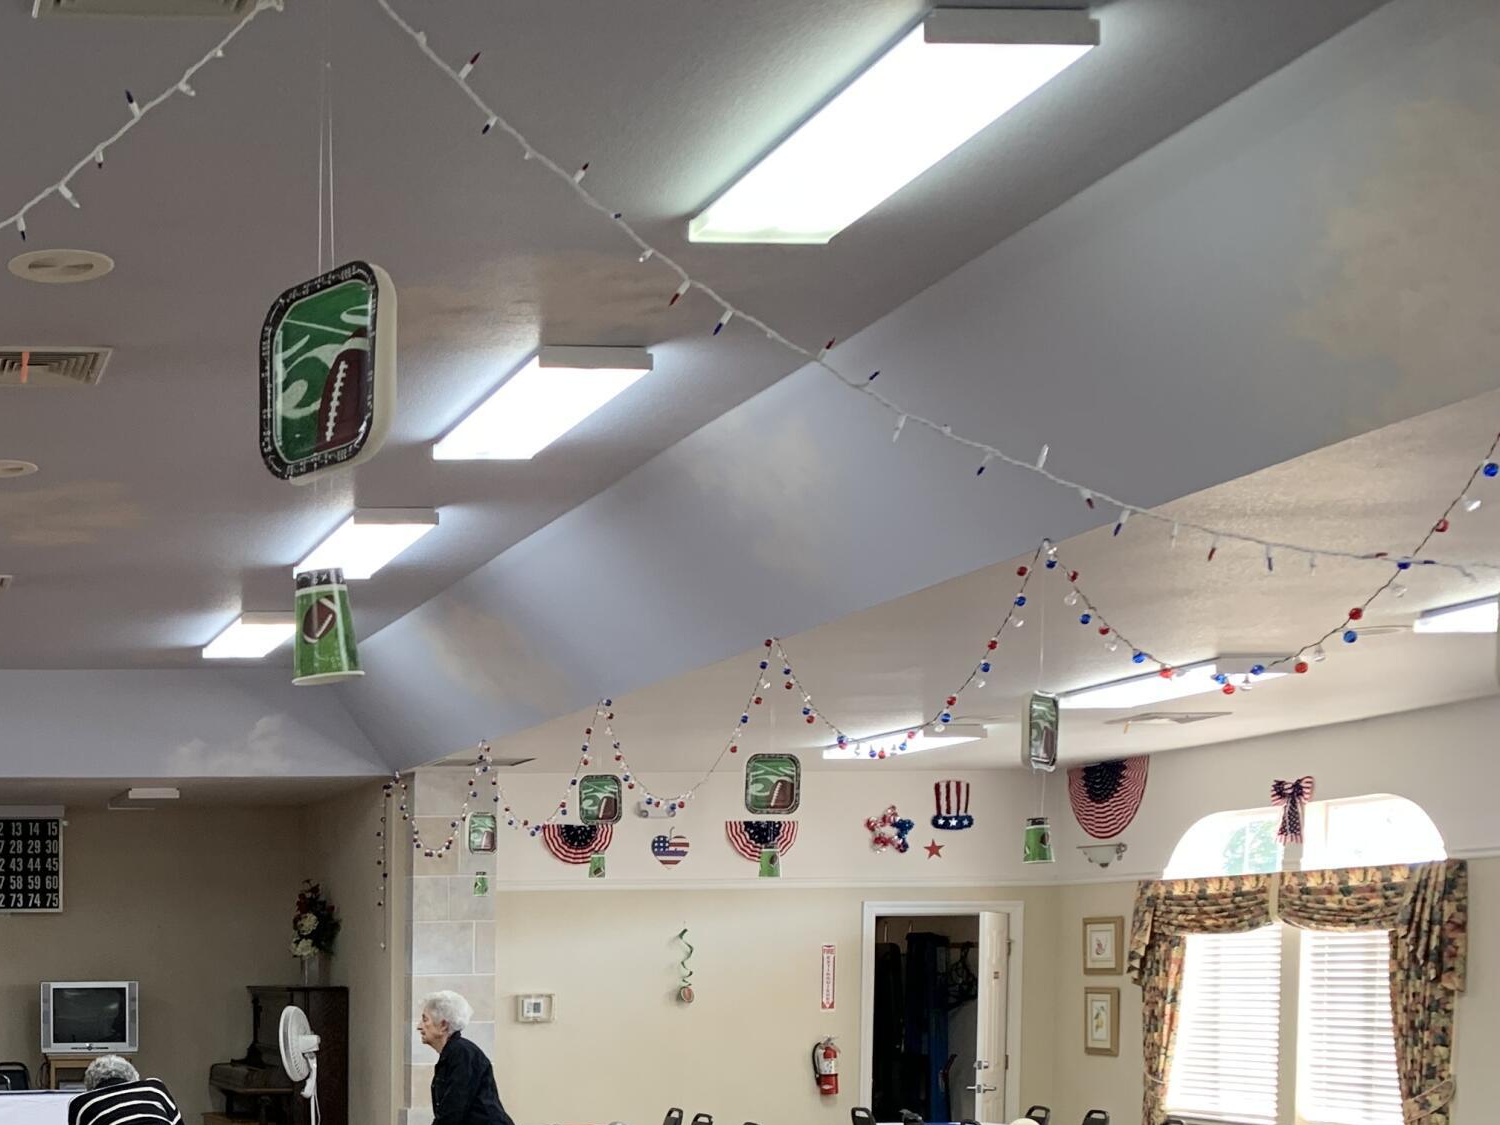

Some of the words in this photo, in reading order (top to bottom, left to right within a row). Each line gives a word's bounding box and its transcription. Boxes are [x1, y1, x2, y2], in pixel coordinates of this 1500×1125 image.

[11, 822, 22, 836] 13
[28, 822, 39, 836] 14
[47, 822, 57, 836] 15
[9, 840, 22, 854] 28
[27, 840, 40, 854] 29
[45, 840, 58, 854] 30
[9, 858, 23, 872] 43
[27, 858, 40, 872] 44
[45, 858, 58, 872] 45
[9, 876, 23, 890] 58
[27, 876, 40, 890] 59
[45, 876, 58, 890] 60
[9, 893, 23, 908] 73
[28, 893, 40, 908] 74
[45, 893, 58, 908] 75
